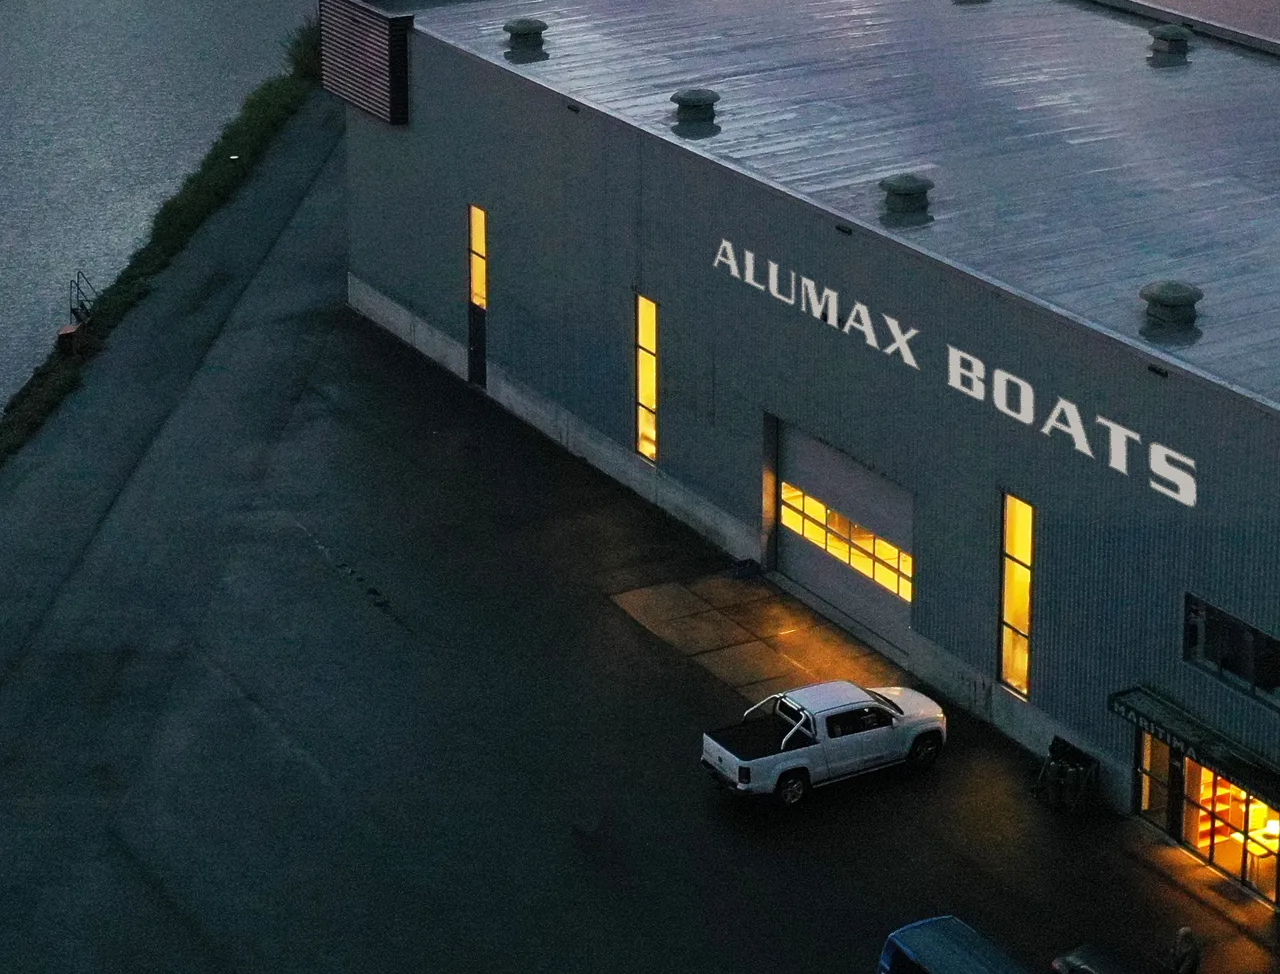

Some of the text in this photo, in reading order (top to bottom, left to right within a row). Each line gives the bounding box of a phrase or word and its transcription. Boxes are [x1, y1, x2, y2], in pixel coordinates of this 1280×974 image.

[713, 238, 1198, 508] ALUMAX BOATS
[1113, 700, 1197, 760] MARITIMA
